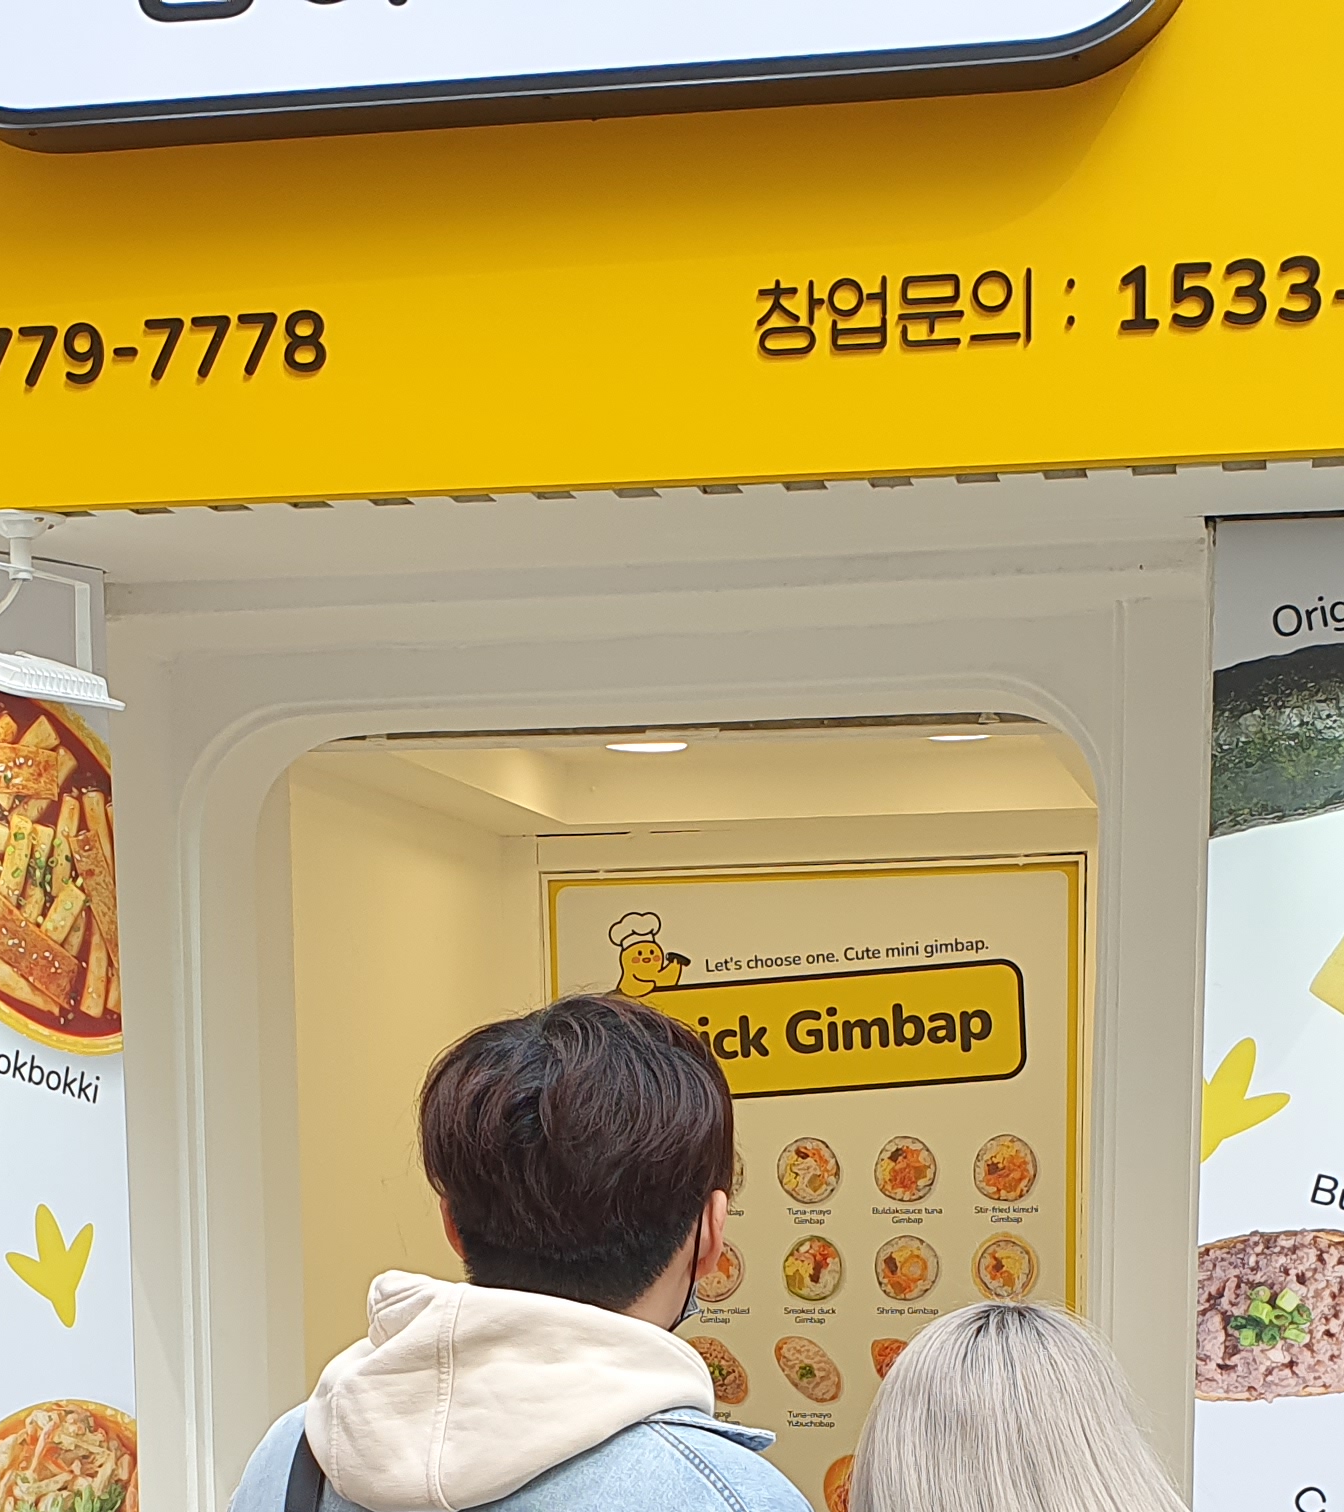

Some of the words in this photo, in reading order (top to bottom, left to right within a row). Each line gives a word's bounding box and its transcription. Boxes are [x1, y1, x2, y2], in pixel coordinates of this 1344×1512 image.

[753, 264, 1034, 358] 창업문의
[705, 956, 742, 974] Let's
[746, 952, 802, 969] choose
[805, 949, 840, 964] one.
[843, 945, 881, 962] Cute
[885, 943, 920, 959] mini
[923, 938, 990, 959] gimbap.
[785, 1002, 993, 1055] Gimbap
[793, 1217, 825, 1226] Gimbap
[891, 1216, 924, 1226] Gimbap
[990, 1215, 1023, 1224] Gimbap
[876, 1306, 906, 1316] Shrimp
[907, 1306, 939, 1316] Gimbap
